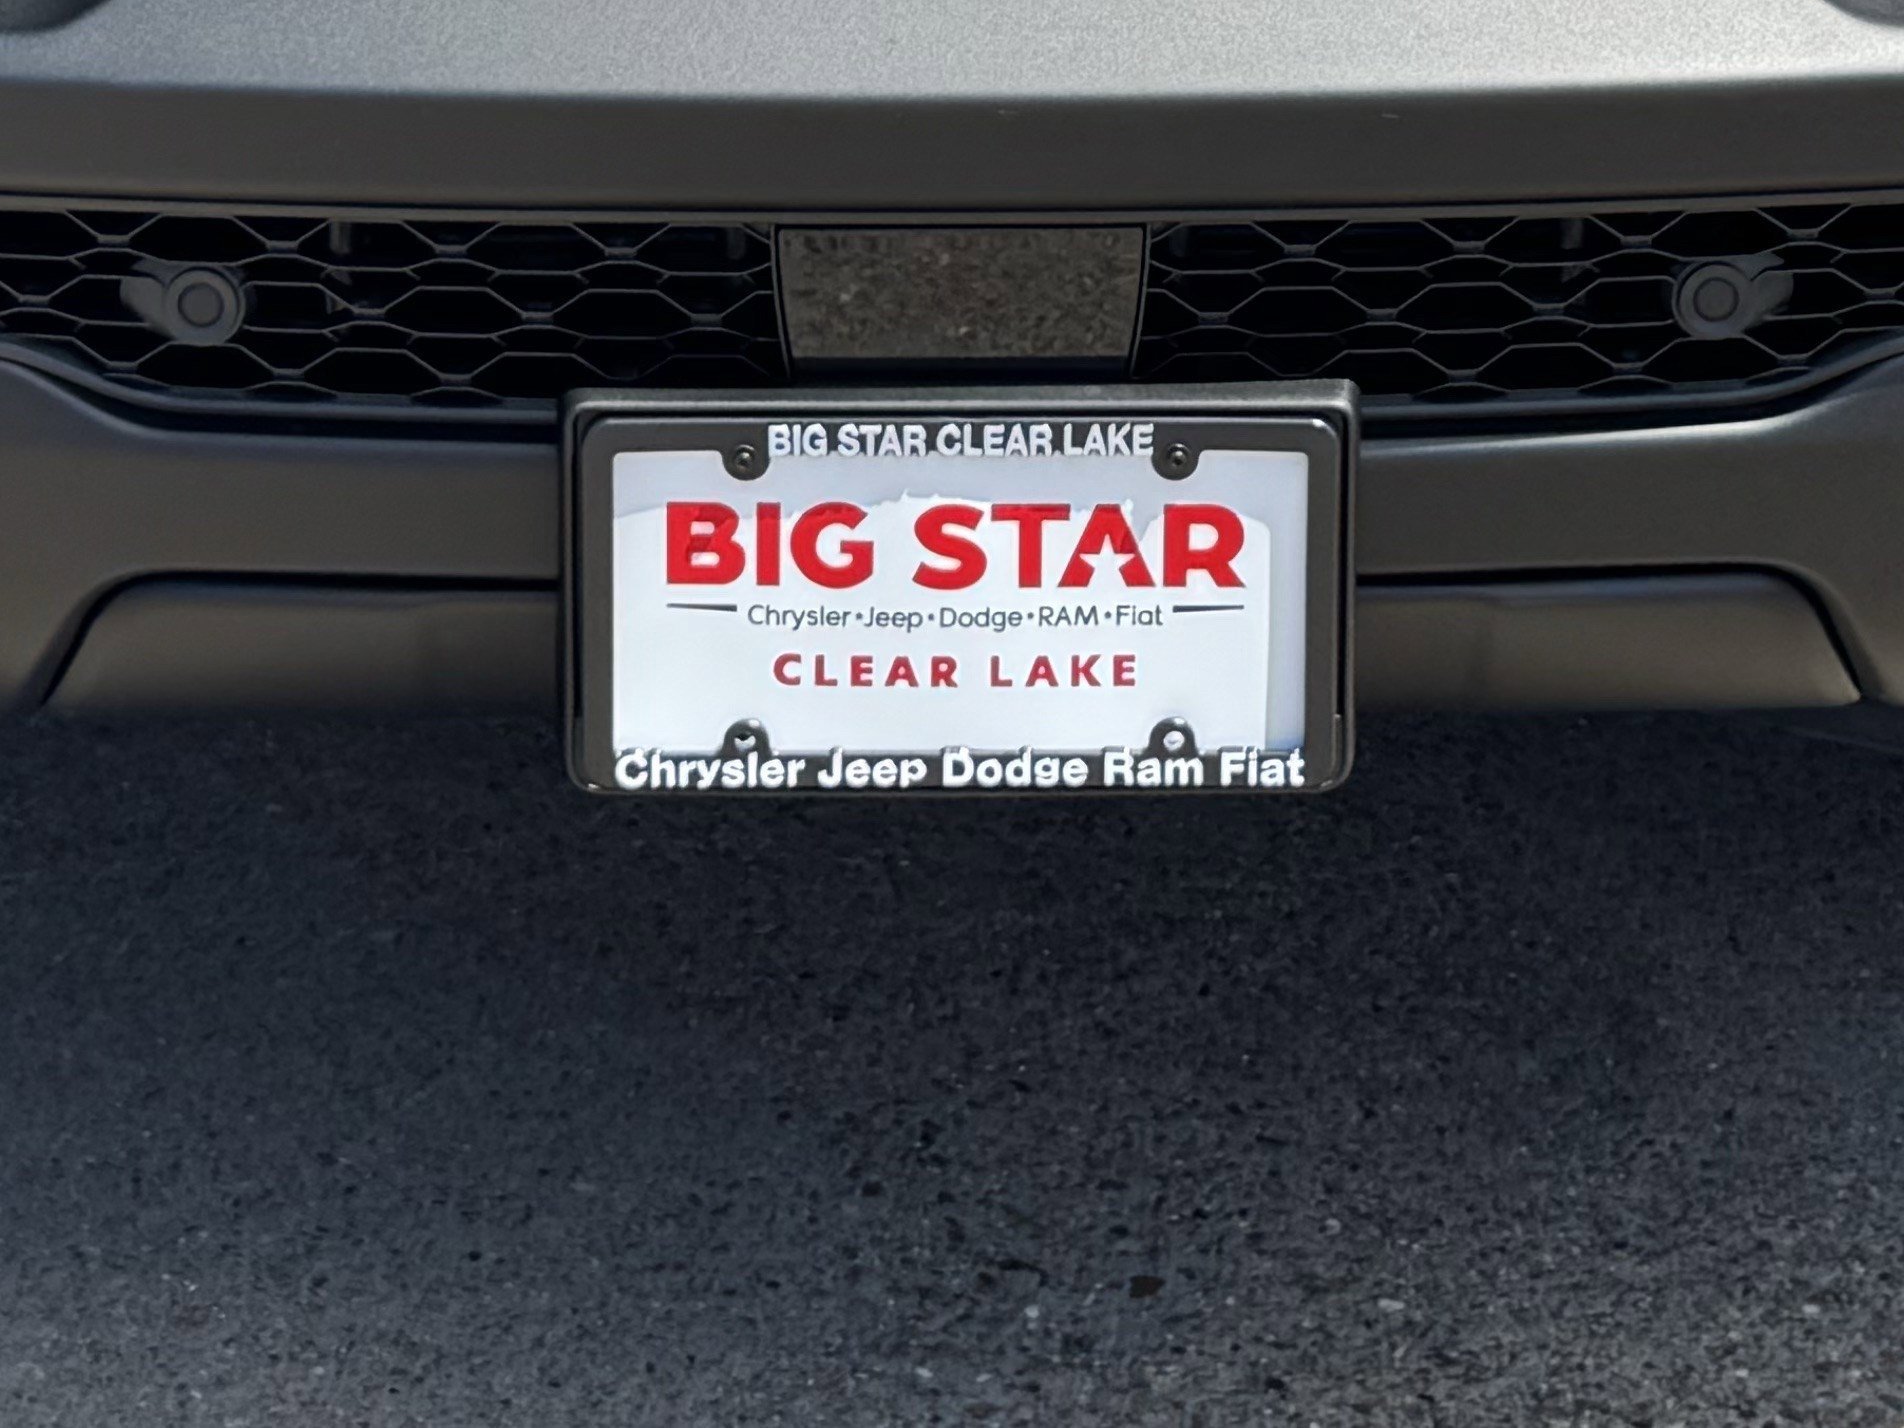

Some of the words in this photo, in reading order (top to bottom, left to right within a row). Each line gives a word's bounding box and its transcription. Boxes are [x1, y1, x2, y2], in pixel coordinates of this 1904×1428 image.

[767, 423, 828, 457] BIG
[837, 423, 927, 457] STAR
[935, 422, 1052, 457] CLEAR
[1063, 422, 1154, 457] LAKE
[666, 501, 874, 589] BIG
[912, 503, 1246, 590] STAR
[773, 653, 958, 688] CLEAR
[990, 654, 1136, 687] LAKE
[615, 748, 805, 790] Chrysler
[817, 746, 927, 789] Jeep
[942, 747, 1089, 788] Dodge
[1103, 747, 1204, 788] Ram
[1220, 747, 1306, 788] Fiat
